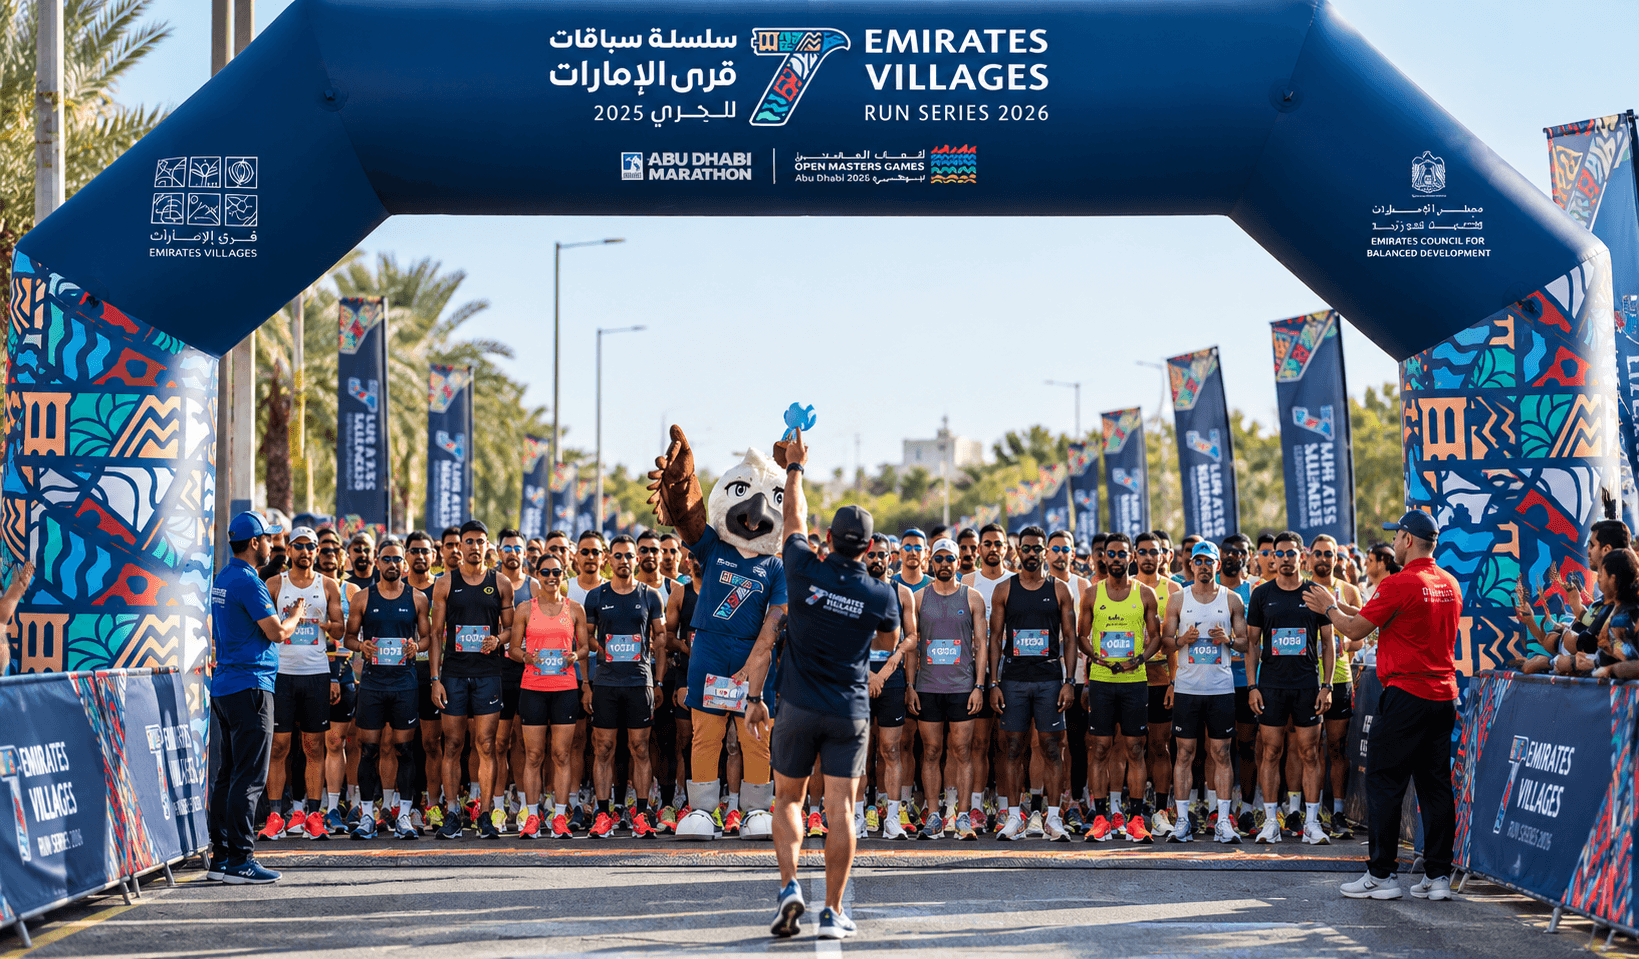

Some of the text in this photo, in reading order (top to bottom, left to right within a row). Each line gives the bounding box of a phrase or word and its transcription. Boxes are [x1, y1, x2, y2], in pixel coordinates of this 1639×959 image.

[549, 27, 738, 54] سلسلة سباقات
[864, 28, 1049, 54] EMIRATES
[549, 59, 738, 96] قرى الإمارات
[864, 62, 1050, 91] VILLAGES
[593, 100, 737, 128] للجري 2025
[864, 104, 1050, 122] RUN SERIES 2026
[648, 151, 752, 167] ABU DHABI
[795, 162, 925, 172] OPEN MASTERS GAMES
[648, 168, 753, 181] MARATHON
[794, 174, 815, 183] Abu
[816, 173, 845, 183] Dhabi
[149, 248, 258, 258] EMIRATES VILLAGES
[1366, 249, 1492, 258] BALANCED DEVELOPMENT
[1371, 237, 1485, 246] EMIRATES COUNCIL FOR
[19, 741, 70, 778] EMIRATES
[1526, 740, 1575, 776] EMIRATES
[28, 781, 78, 823] VILLAGES
[1516, 777, 1564, 818] VILLAGES
